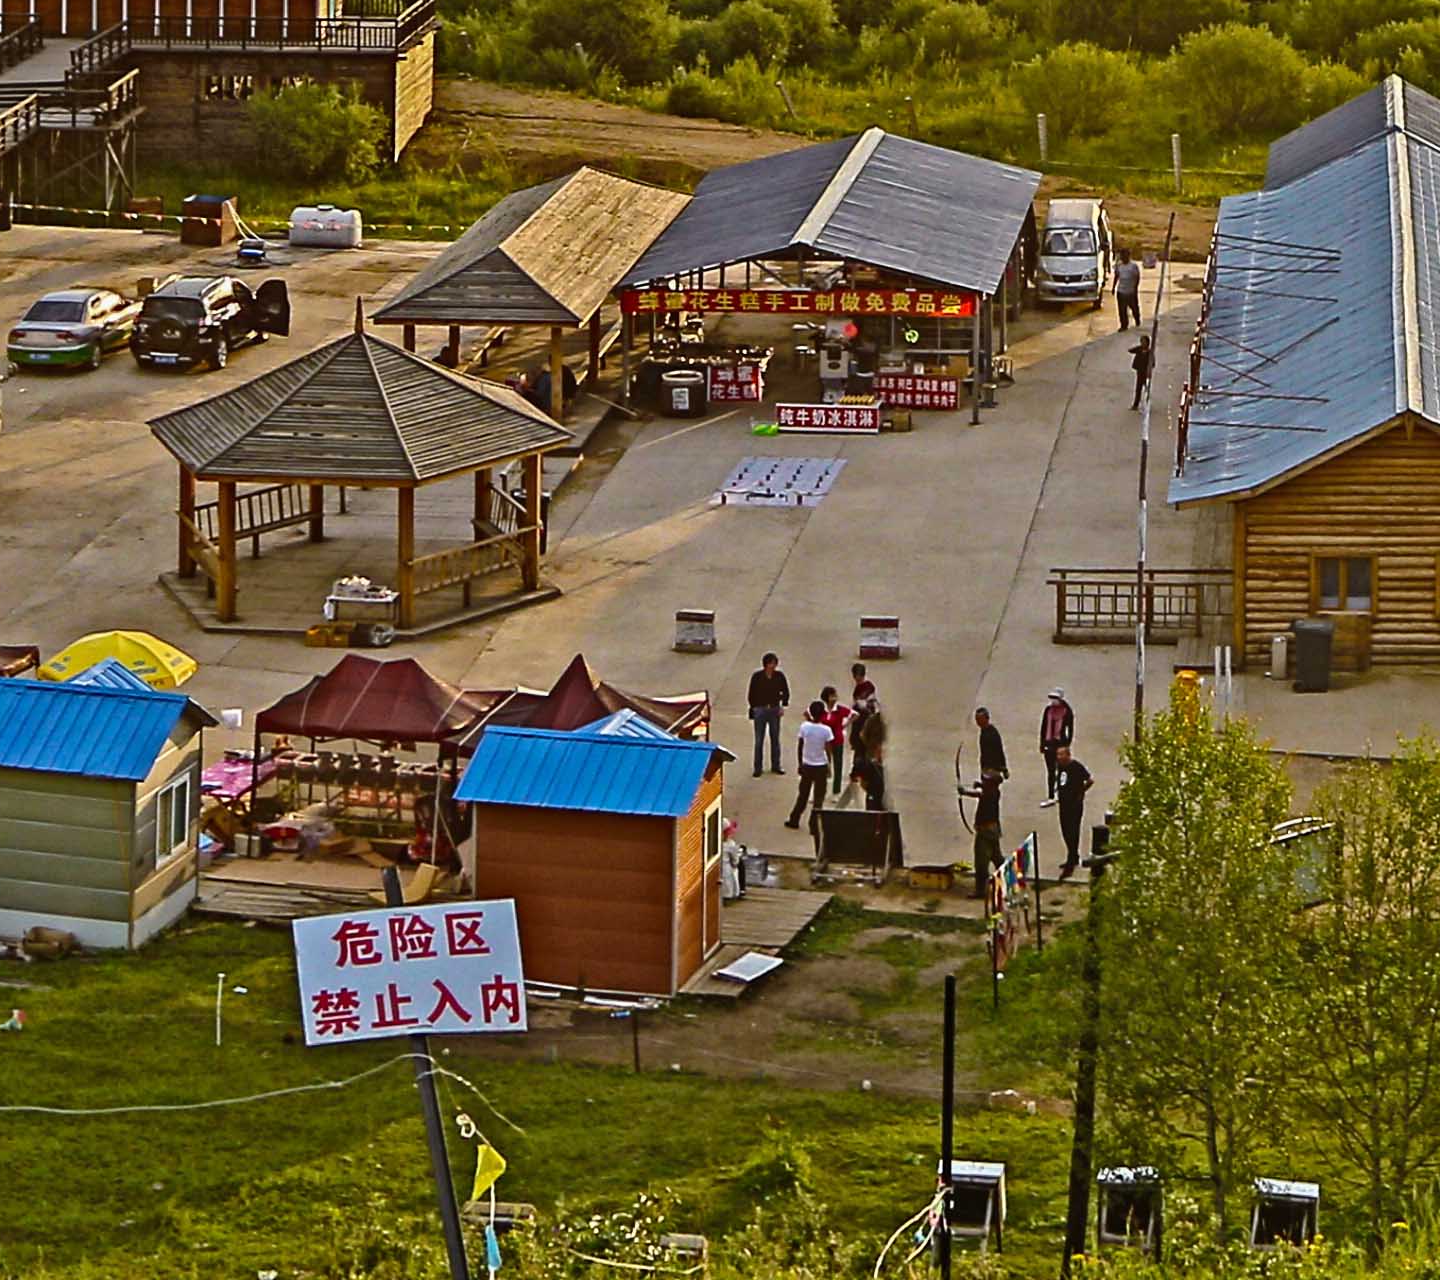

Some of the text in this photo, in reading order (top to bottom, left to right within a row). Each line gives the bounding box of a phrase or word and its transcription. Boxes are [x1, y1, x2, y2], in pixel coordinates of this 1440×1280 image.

[780, 407, 874, 427] 纯牛奶冰淇淋
[332, 911, 491, 967] 危险区
[312, 973, 522, 1036] 禁止入内
